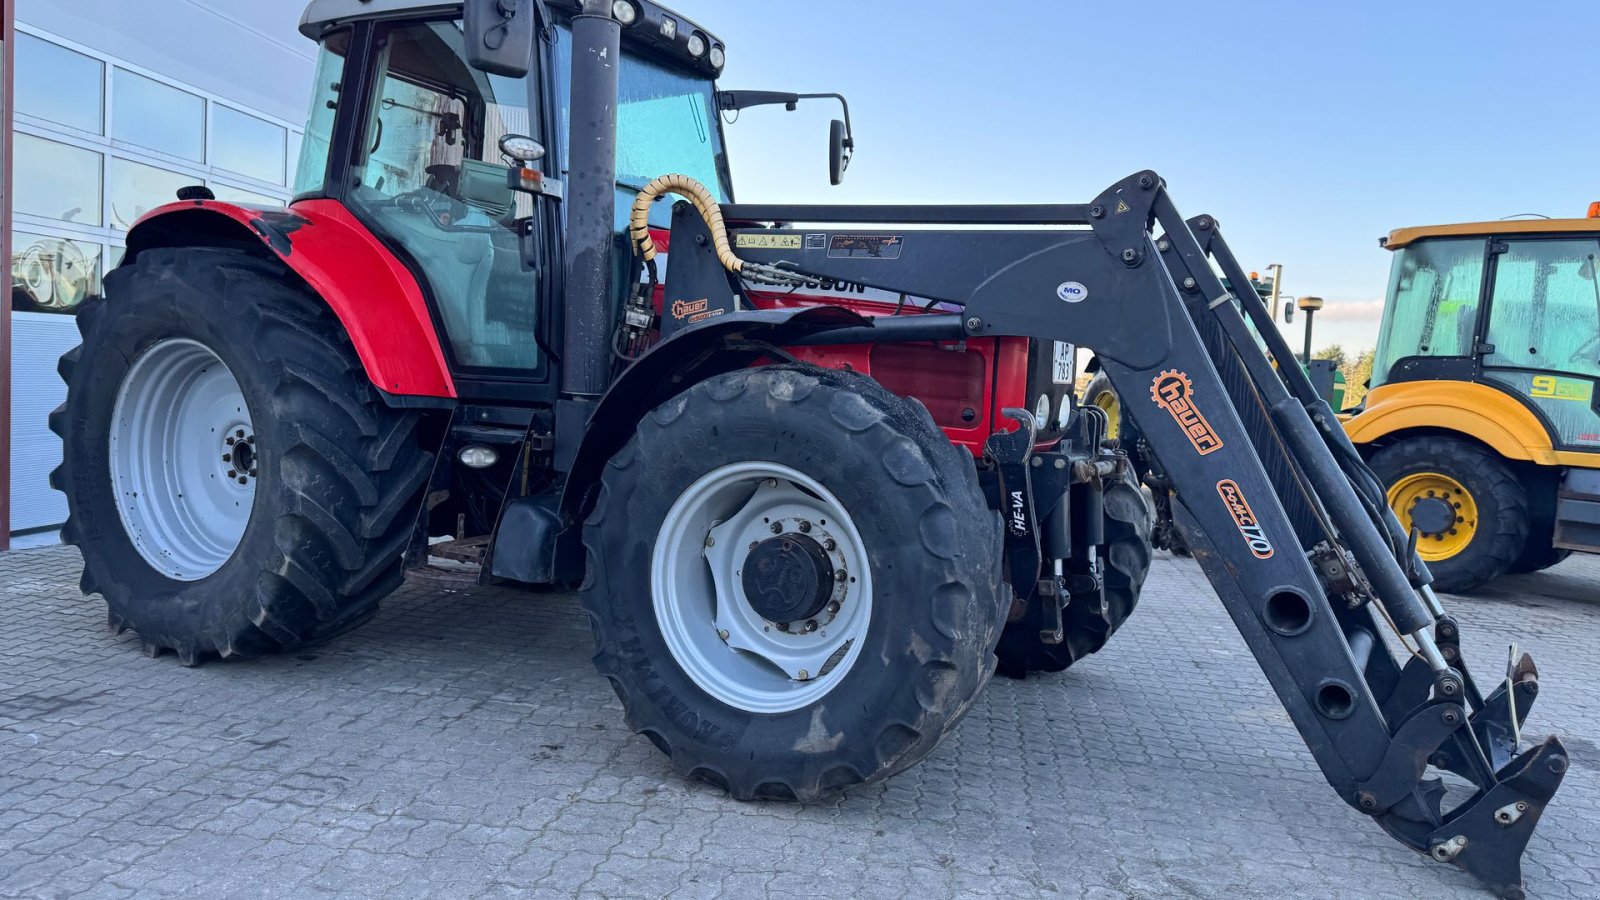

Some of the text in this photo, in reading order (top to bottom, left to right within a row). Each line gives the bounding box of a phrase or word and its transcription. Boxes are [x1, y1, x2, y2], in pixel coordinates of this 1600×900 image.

[1064, 287, 1081, 295] MO
[677, 301, 706, 315] hauer
[1057, 361, 1069, 380] 783
[1160, 381, 1216, 448] hauer
[1011, 490, 1026, 531] HE-VA
